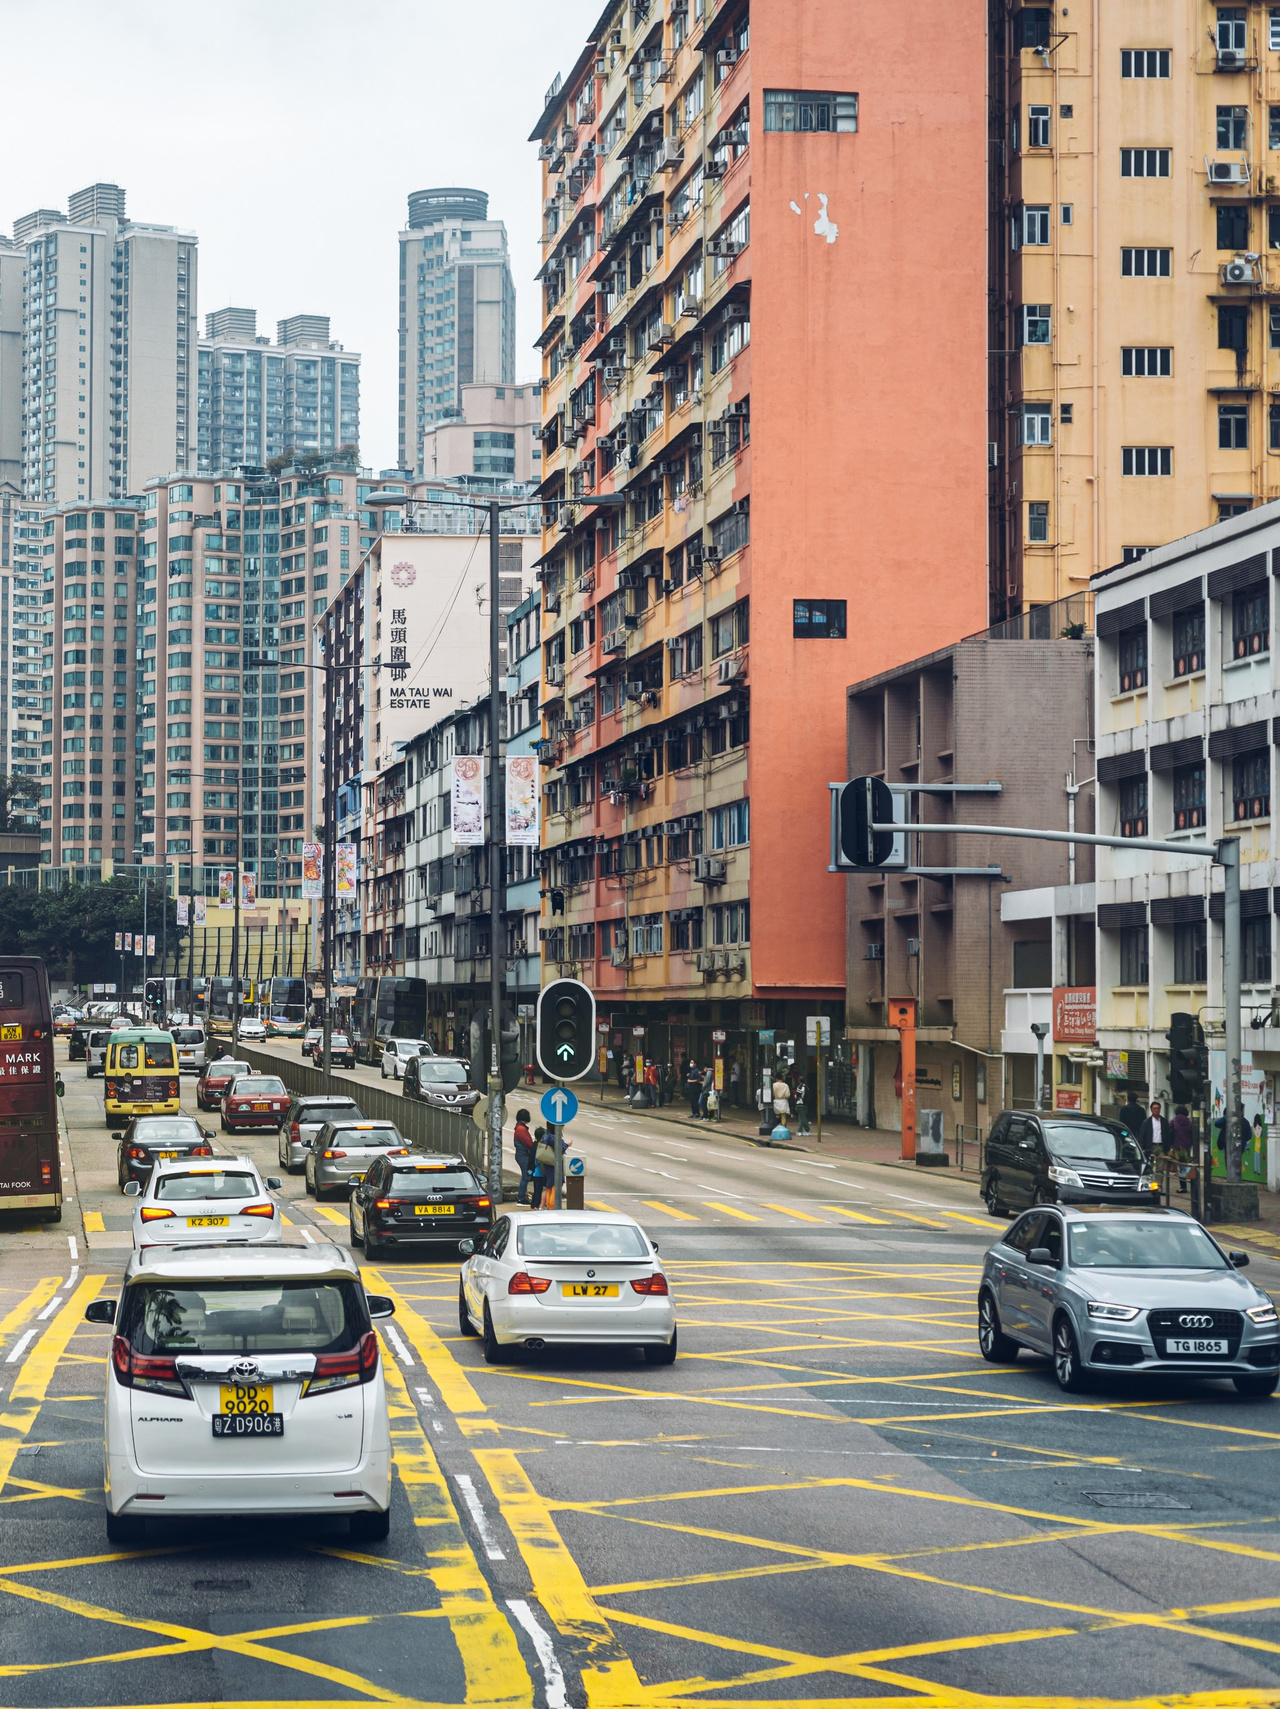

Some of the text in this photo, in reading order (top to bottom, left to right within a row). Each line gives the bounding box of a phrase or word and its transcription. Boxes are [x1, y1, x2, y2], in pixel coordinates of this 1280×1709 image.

[390, 688, 452, 697] MA TAU WAI
[390, 699, 430, 708] ESTATE
[6, 1052, 41, 1064] MARK
[11, 1181, 32, 1189] FOOK
[192, 1218, 224, 1226] KZ 307
[573, 1286, 608, 1295] LW 27
[1174, 1341, 1222, 1352] TG 1865
[236, 1386, 258, 1400] DD
[225, 1400, 269, 1414] 9020
